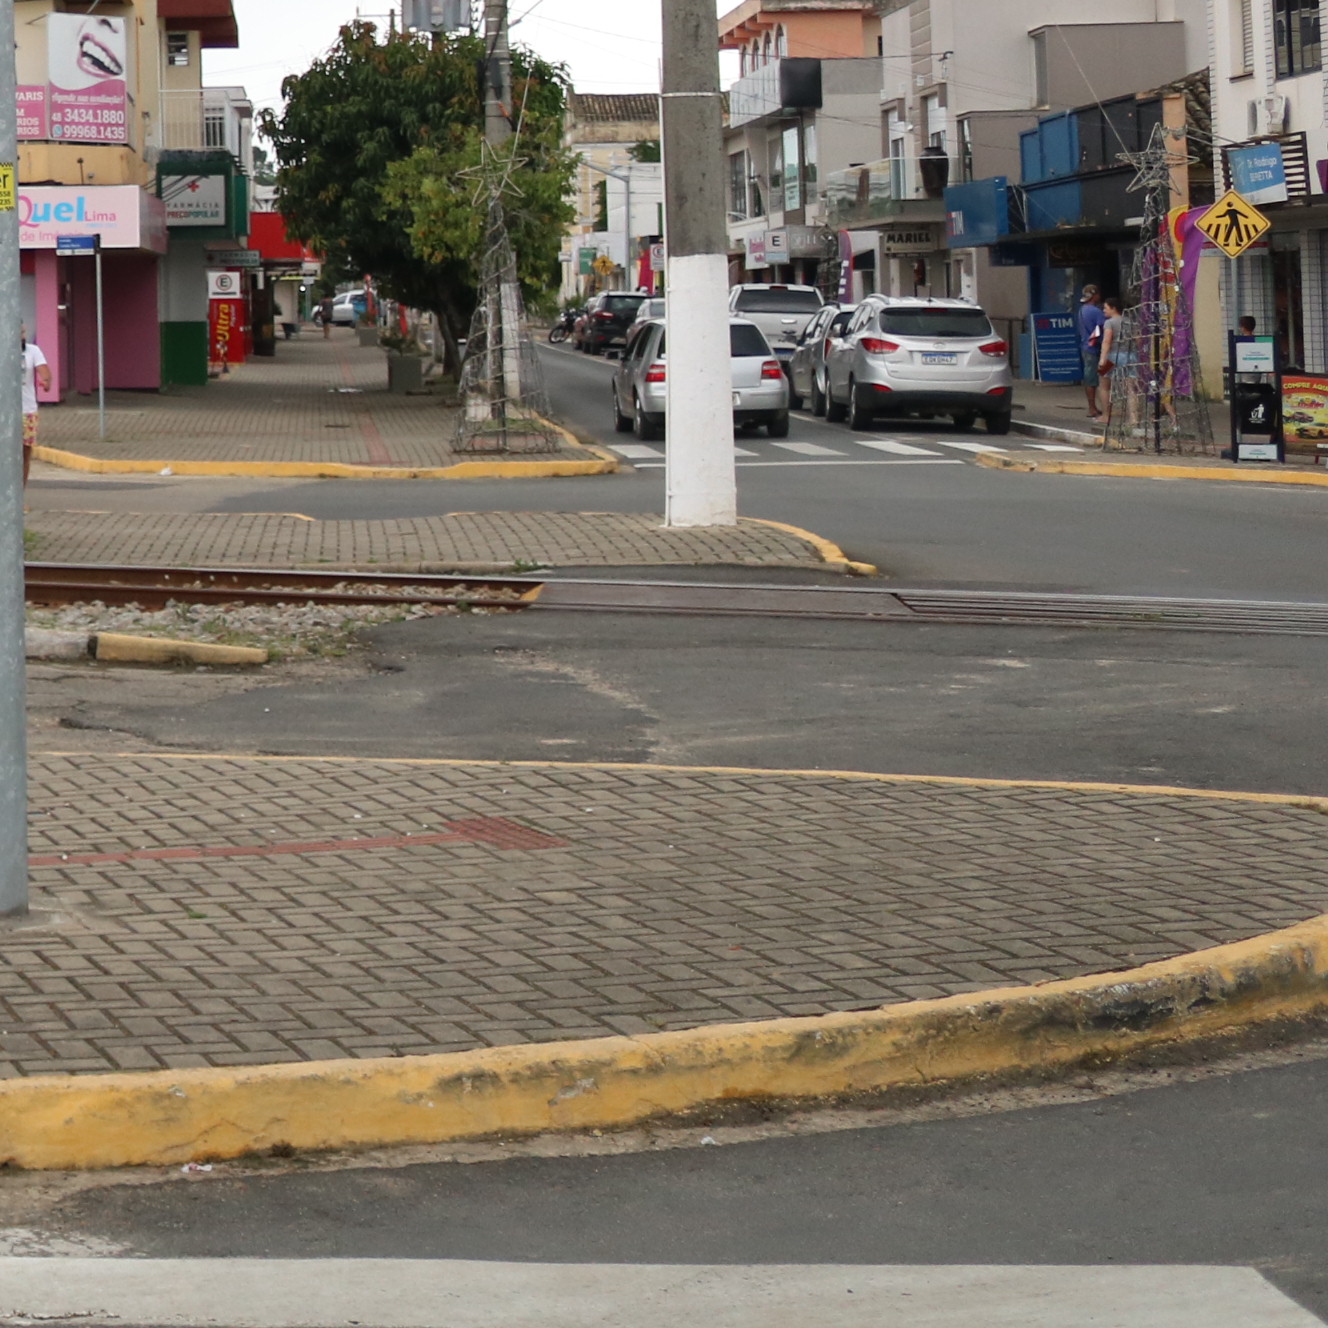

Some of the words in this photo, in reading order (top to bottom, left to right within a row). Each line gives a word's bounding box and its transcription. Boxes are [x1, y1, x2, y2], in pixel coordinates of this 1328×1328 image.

[64, 109, 124, 124] 3434.1880
[63, 125, 125, 139] 99968.1435
[772, 235, 780, 247] E
[220, 277, 228, 287] E
[1049, 317, 1073, 328] TIM
